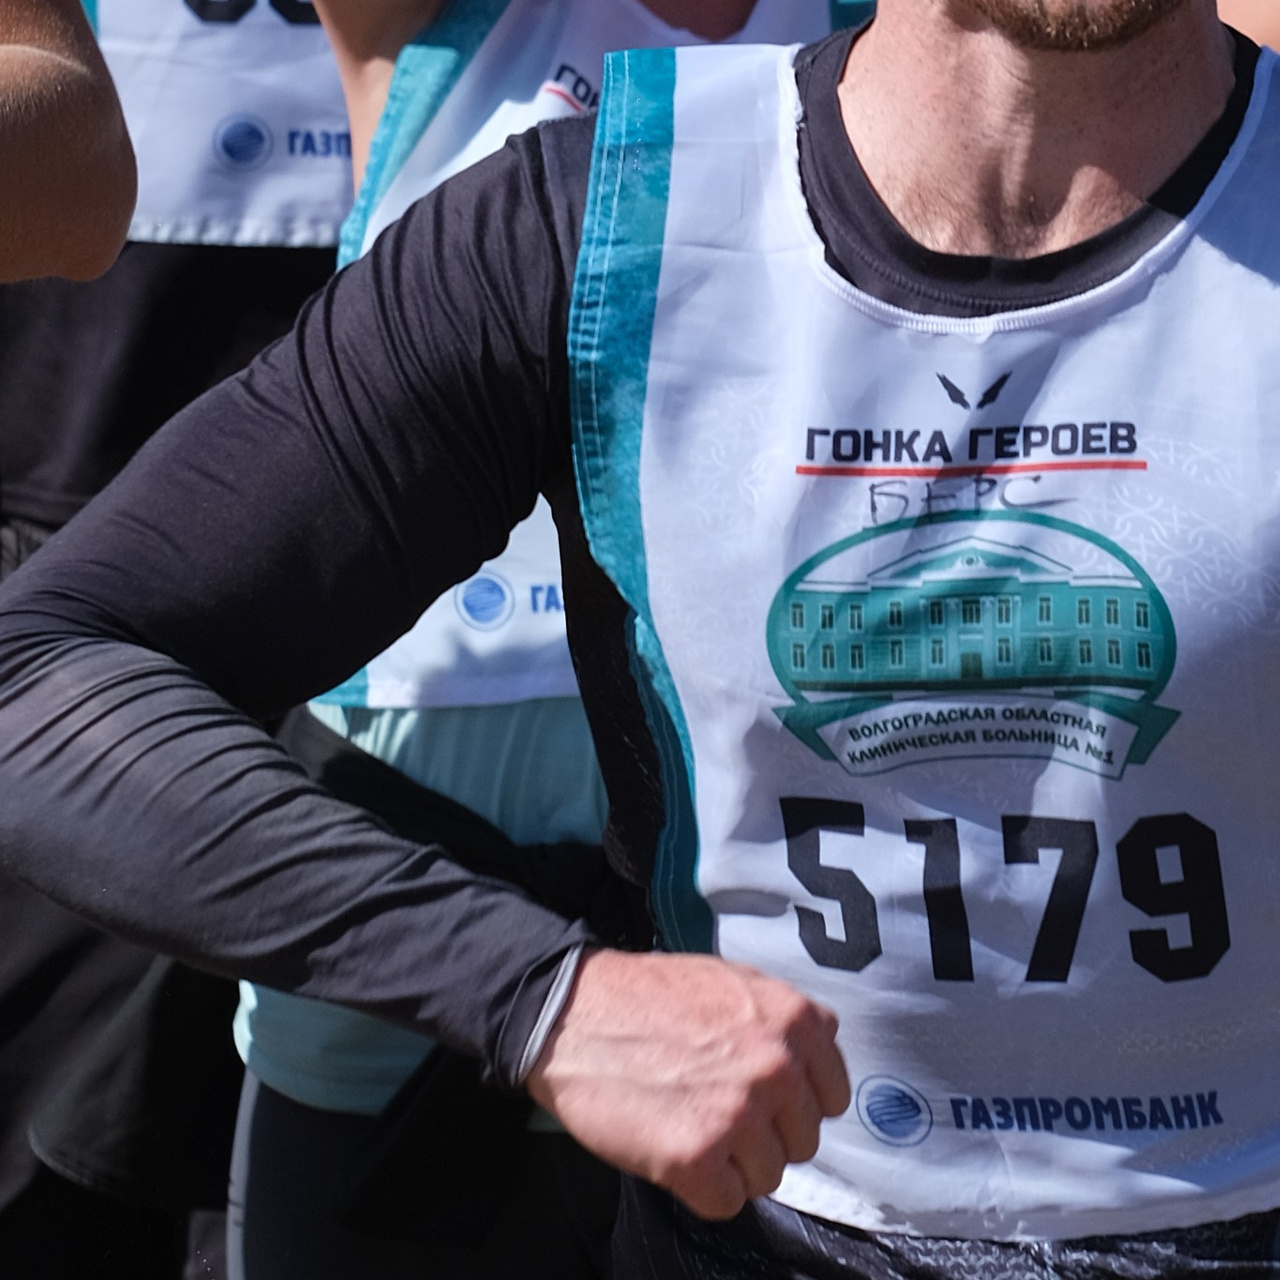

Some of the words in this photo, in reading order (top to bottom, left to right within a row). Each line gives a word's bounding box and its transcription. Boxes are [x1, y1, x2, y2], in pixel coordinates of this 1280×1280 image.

[805, 427, 952, 464] ГОНКА
[968, 422, 1138, 461] ГЕРОЕВ
[848, 707, 996, 742] ВОЛГОГРАДСКАЯ
[1001, 706, 1107, 739] ОБЛАСТНАЯ
[847, 729, 976, 764] КЛИНИЧЕСКАЯ
[982, 729, 1079, 752] БОЛЬНИЦА
[779, 797, 1231, 983] 5179
[950, 1091, 1224, 1132] ГАЗПРОМБАНК
